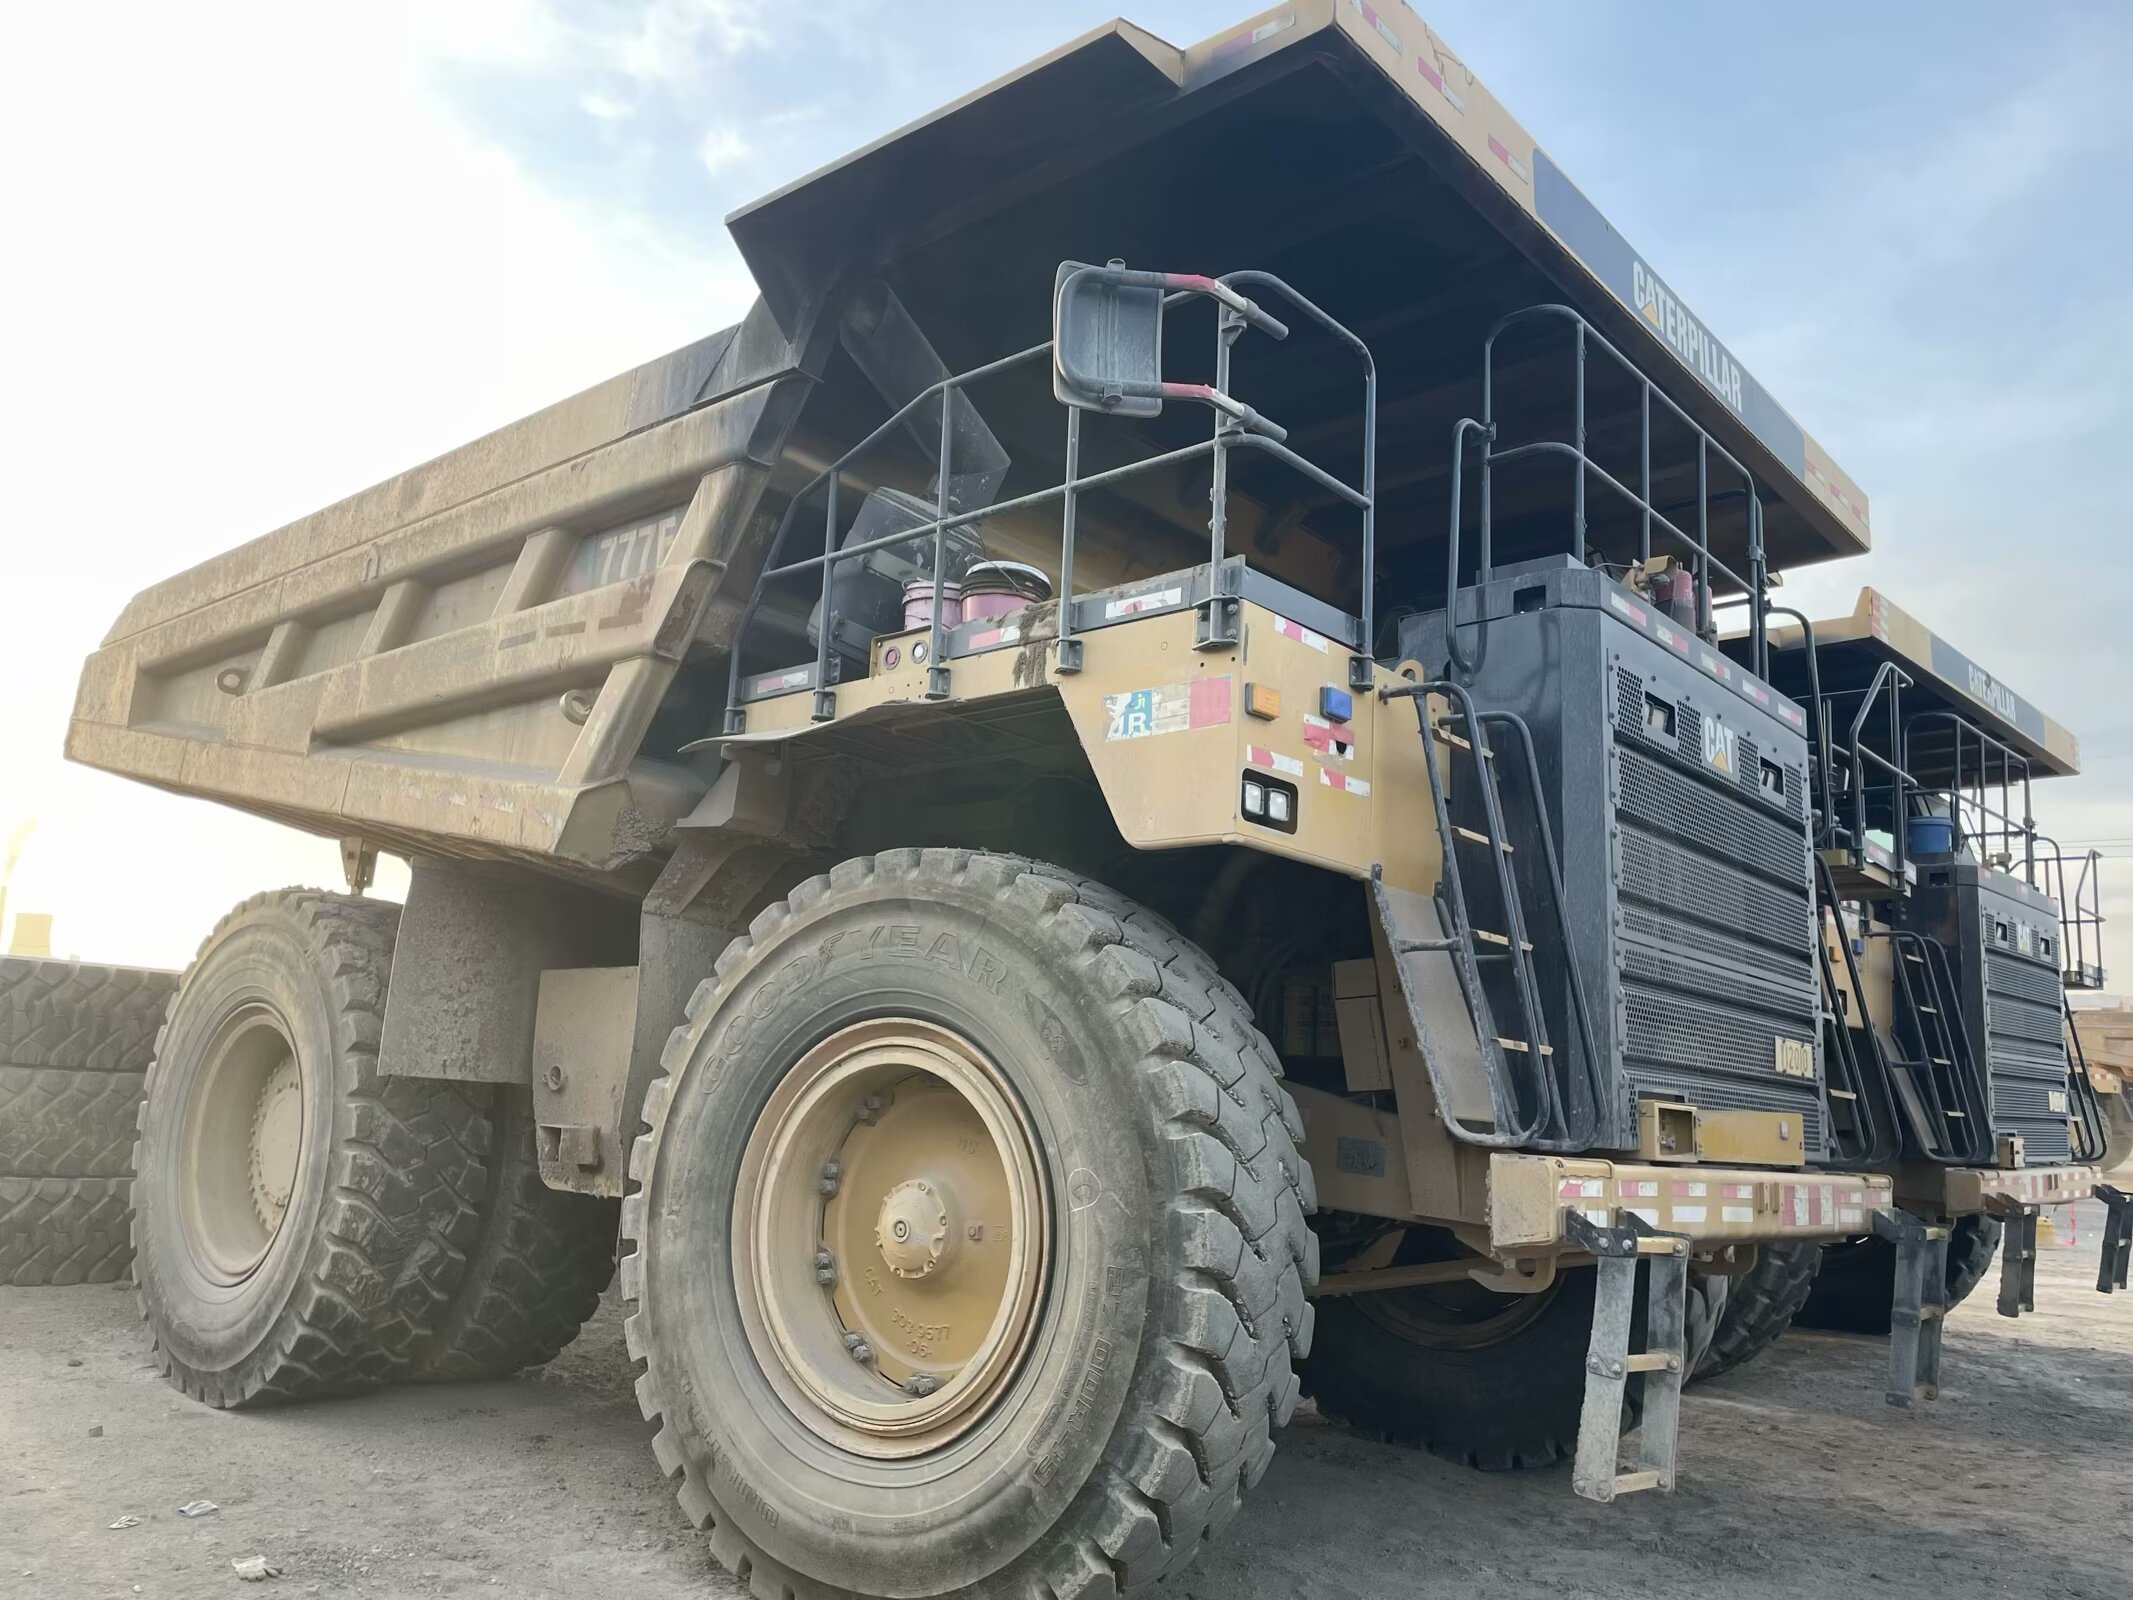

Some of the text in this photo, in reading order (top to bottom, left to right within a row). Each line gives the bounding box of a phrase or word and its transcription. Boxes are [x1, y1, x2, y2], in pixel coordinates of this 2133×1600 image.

[1633, 260, 1743, 414] CATERPILLAR
[1968, 663, 2017, 723] CATERPILLAR
[1704, 716, 1734, 774] CAT
